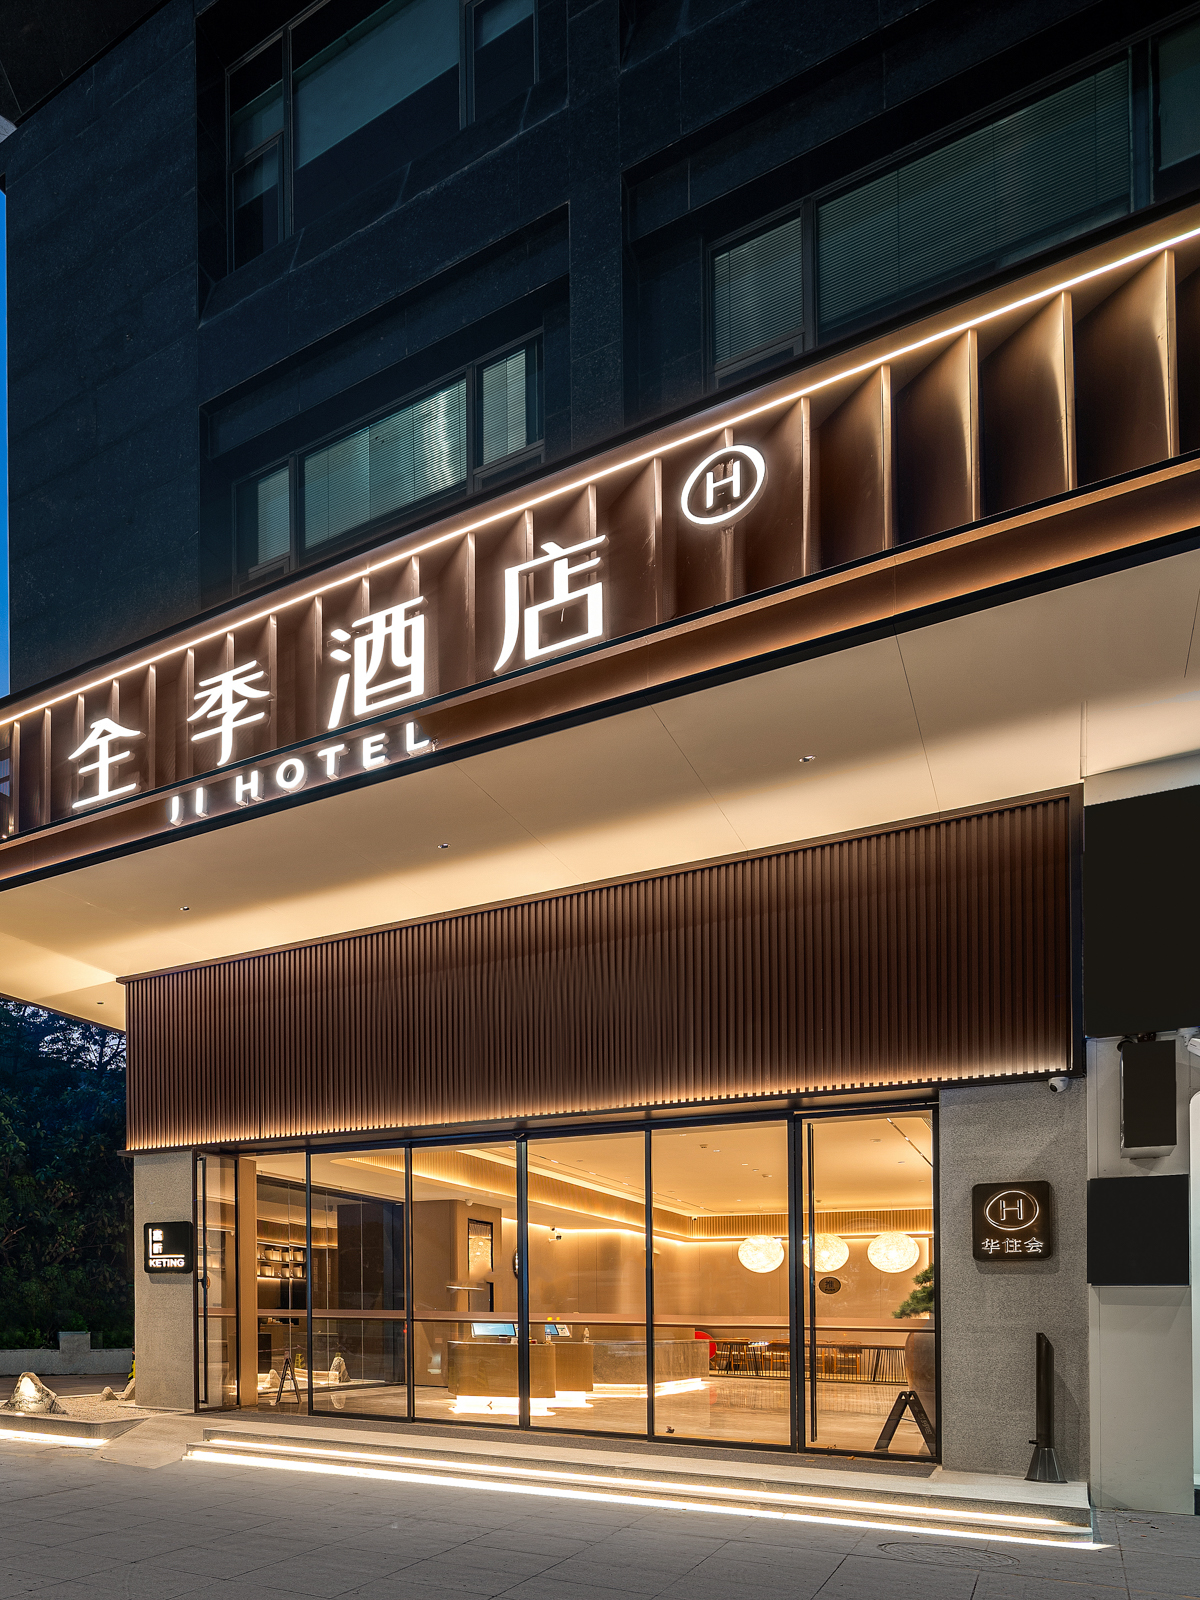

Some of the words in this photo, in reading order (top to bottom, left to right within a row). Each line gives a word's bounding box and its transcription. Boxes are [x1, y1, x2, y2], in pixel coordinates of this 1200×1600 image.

[68, 534, 606, 810] 全季酒店
[170, 786, 206, 825] JI
[234, 721, 430, 806] HOTEL
[149, 1258, 185, 1268] KETING
[981, 1237, 1044, 1254] 华住会
